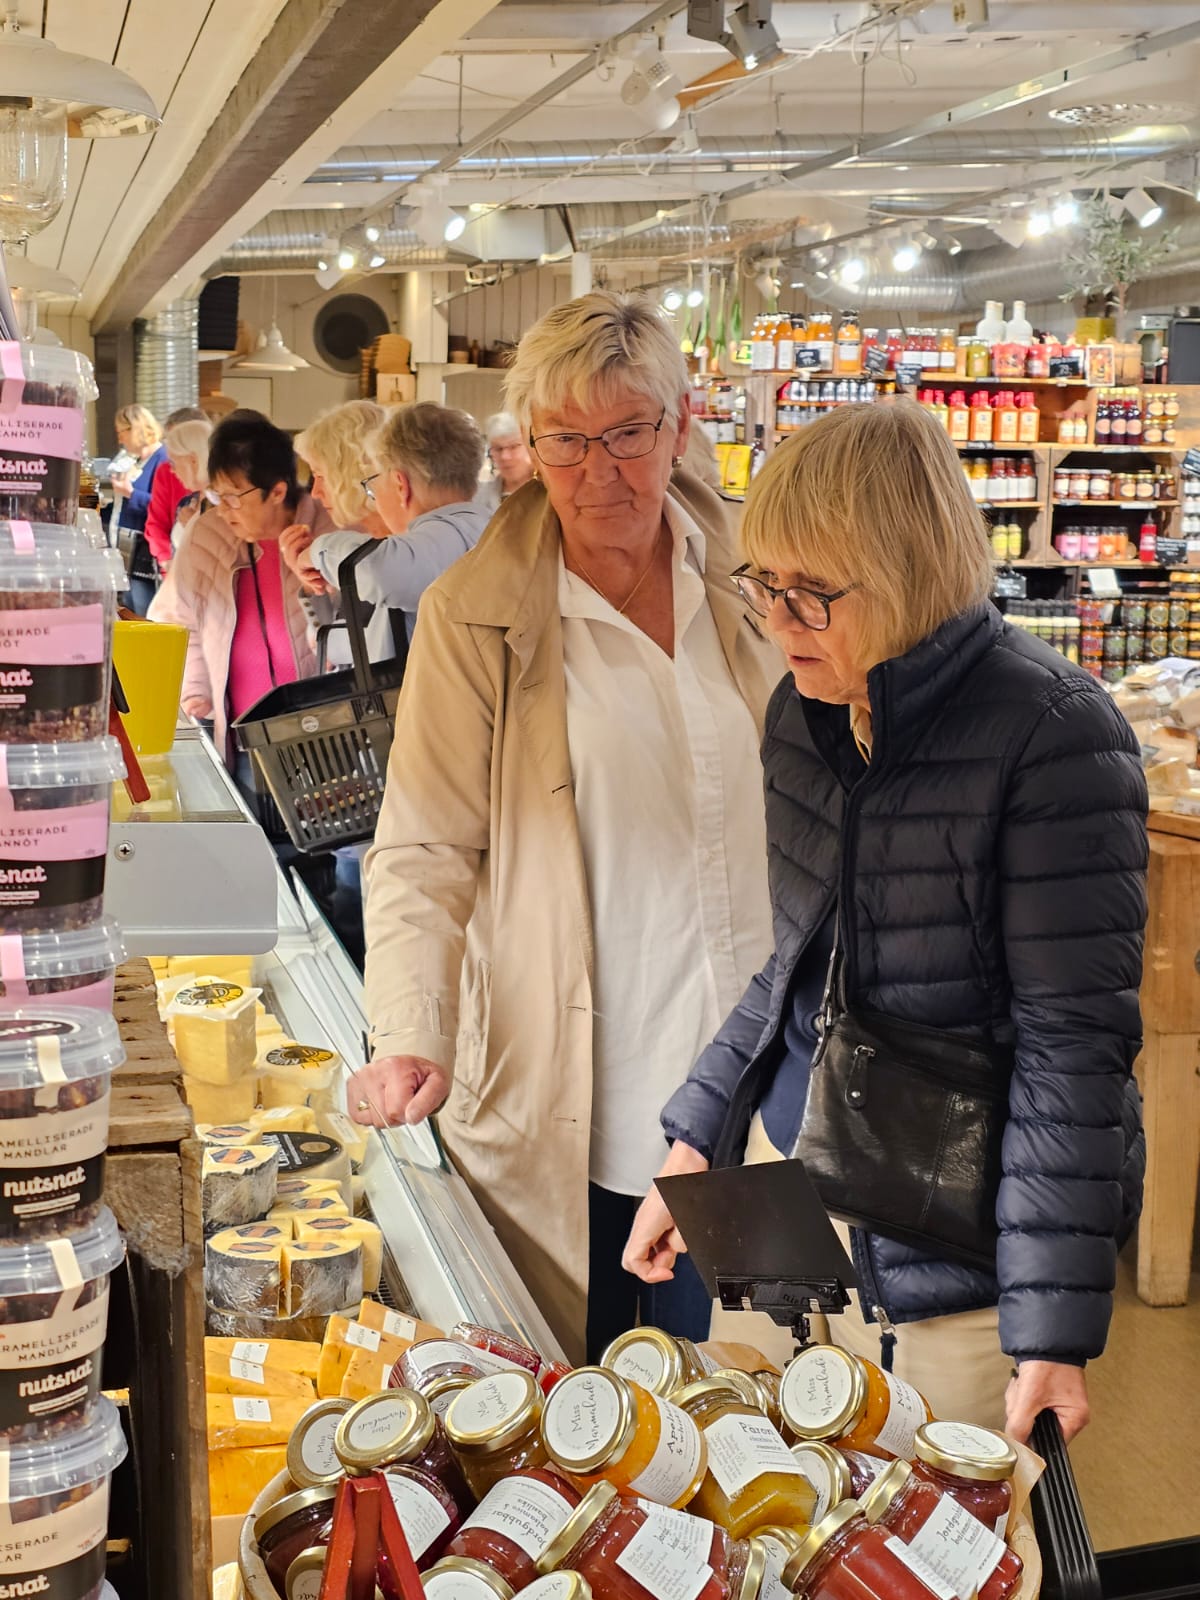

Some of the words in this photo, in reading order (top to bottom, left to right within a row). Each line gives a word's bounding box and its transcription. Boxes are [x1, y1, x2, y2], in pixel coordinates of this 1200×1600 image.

[0, 429, 42, 439] ANNÖT
[3, 1144, 68, 1160] MANDLAR
[3, 1165, 87, 1197] nutsnat
[18, 1341, 78, 1362] MANDLAR
[19, 1358, 94, 1397] nutsnat
[805, 1376, 817, 1402] Miss
[569, 1402, 582, 1432] Miss
[582, 1375, 599, 1451] Marmalade
[490, 1508, 548, 1549] Jordgubbar
